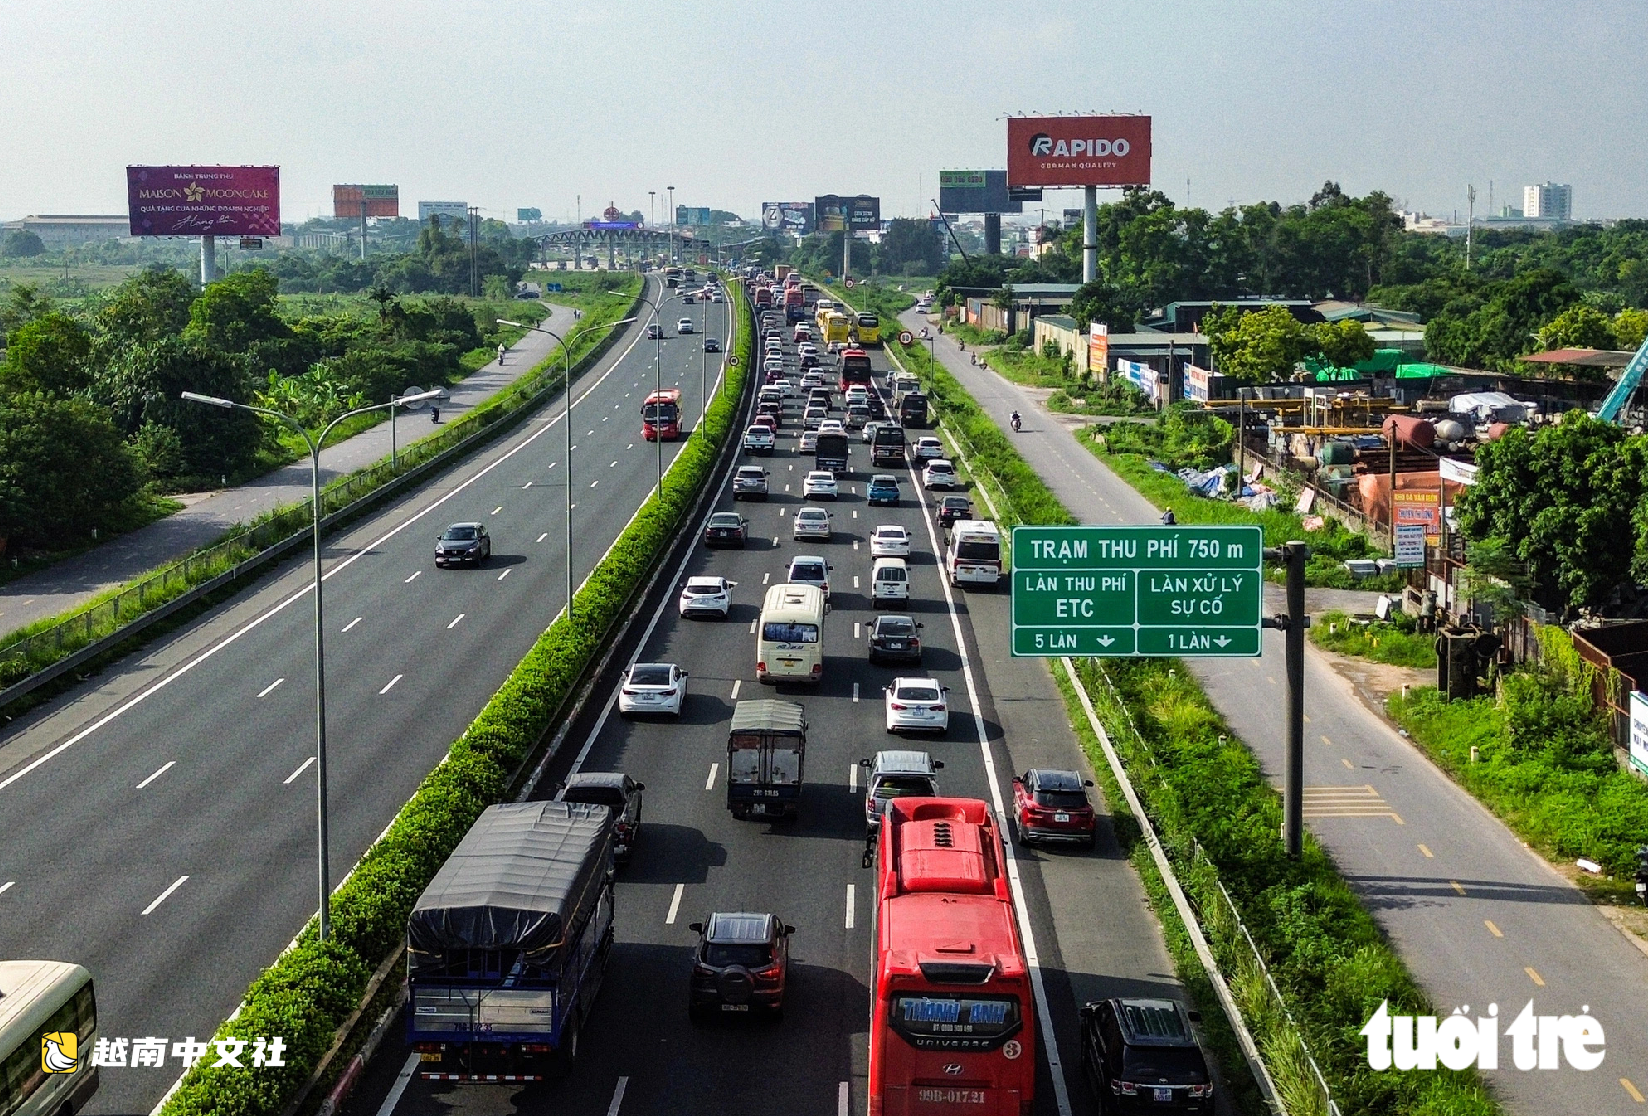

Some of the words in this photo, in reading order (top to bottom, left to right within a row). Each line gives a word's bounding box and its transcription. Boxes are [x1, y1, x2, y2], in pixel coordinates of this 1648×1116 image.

[1031, 137, 1130, 157] RAPIDO
[139, 189, 182, 198] MAISON
[206, 189, 269, 198] MOONCAKE
[1031, 539, 1088, 564] TRẠM
[1098, 541, 1136, 558] THU
[1147, 534, 1179, 558] PHÍ
[1188, 540, 1220, 558] 750
[1227, 543, 1243, 558] m
[1025, 572, 1058, 592] LÀN
[1065, 577, 1095, 591] THU
[1102, 573, 1126, 591] PHÍ
[1151, 572, 1187, 593] LÀN
[1193, 572, 1219, 592] XỬ
[1222, 574, 1243, 592] LÝ
[1056, 598, 1094, 618] ETC
[1171, 599, 1196, 618] SỰ
[1200, 594, 1223, 615] CỐ
[1035, 634, 1044, 648] 5
[1050, 630, 1077, 648] LÀN
[1168, 634, 1174, 649] 1
[1179, 631, 1210, 649] LÀN
[904, 1000, 960, 1023] THANH
[969, 1003, 1006, 1024] ANH
[1005, 1043, 1018, 1056] 3
